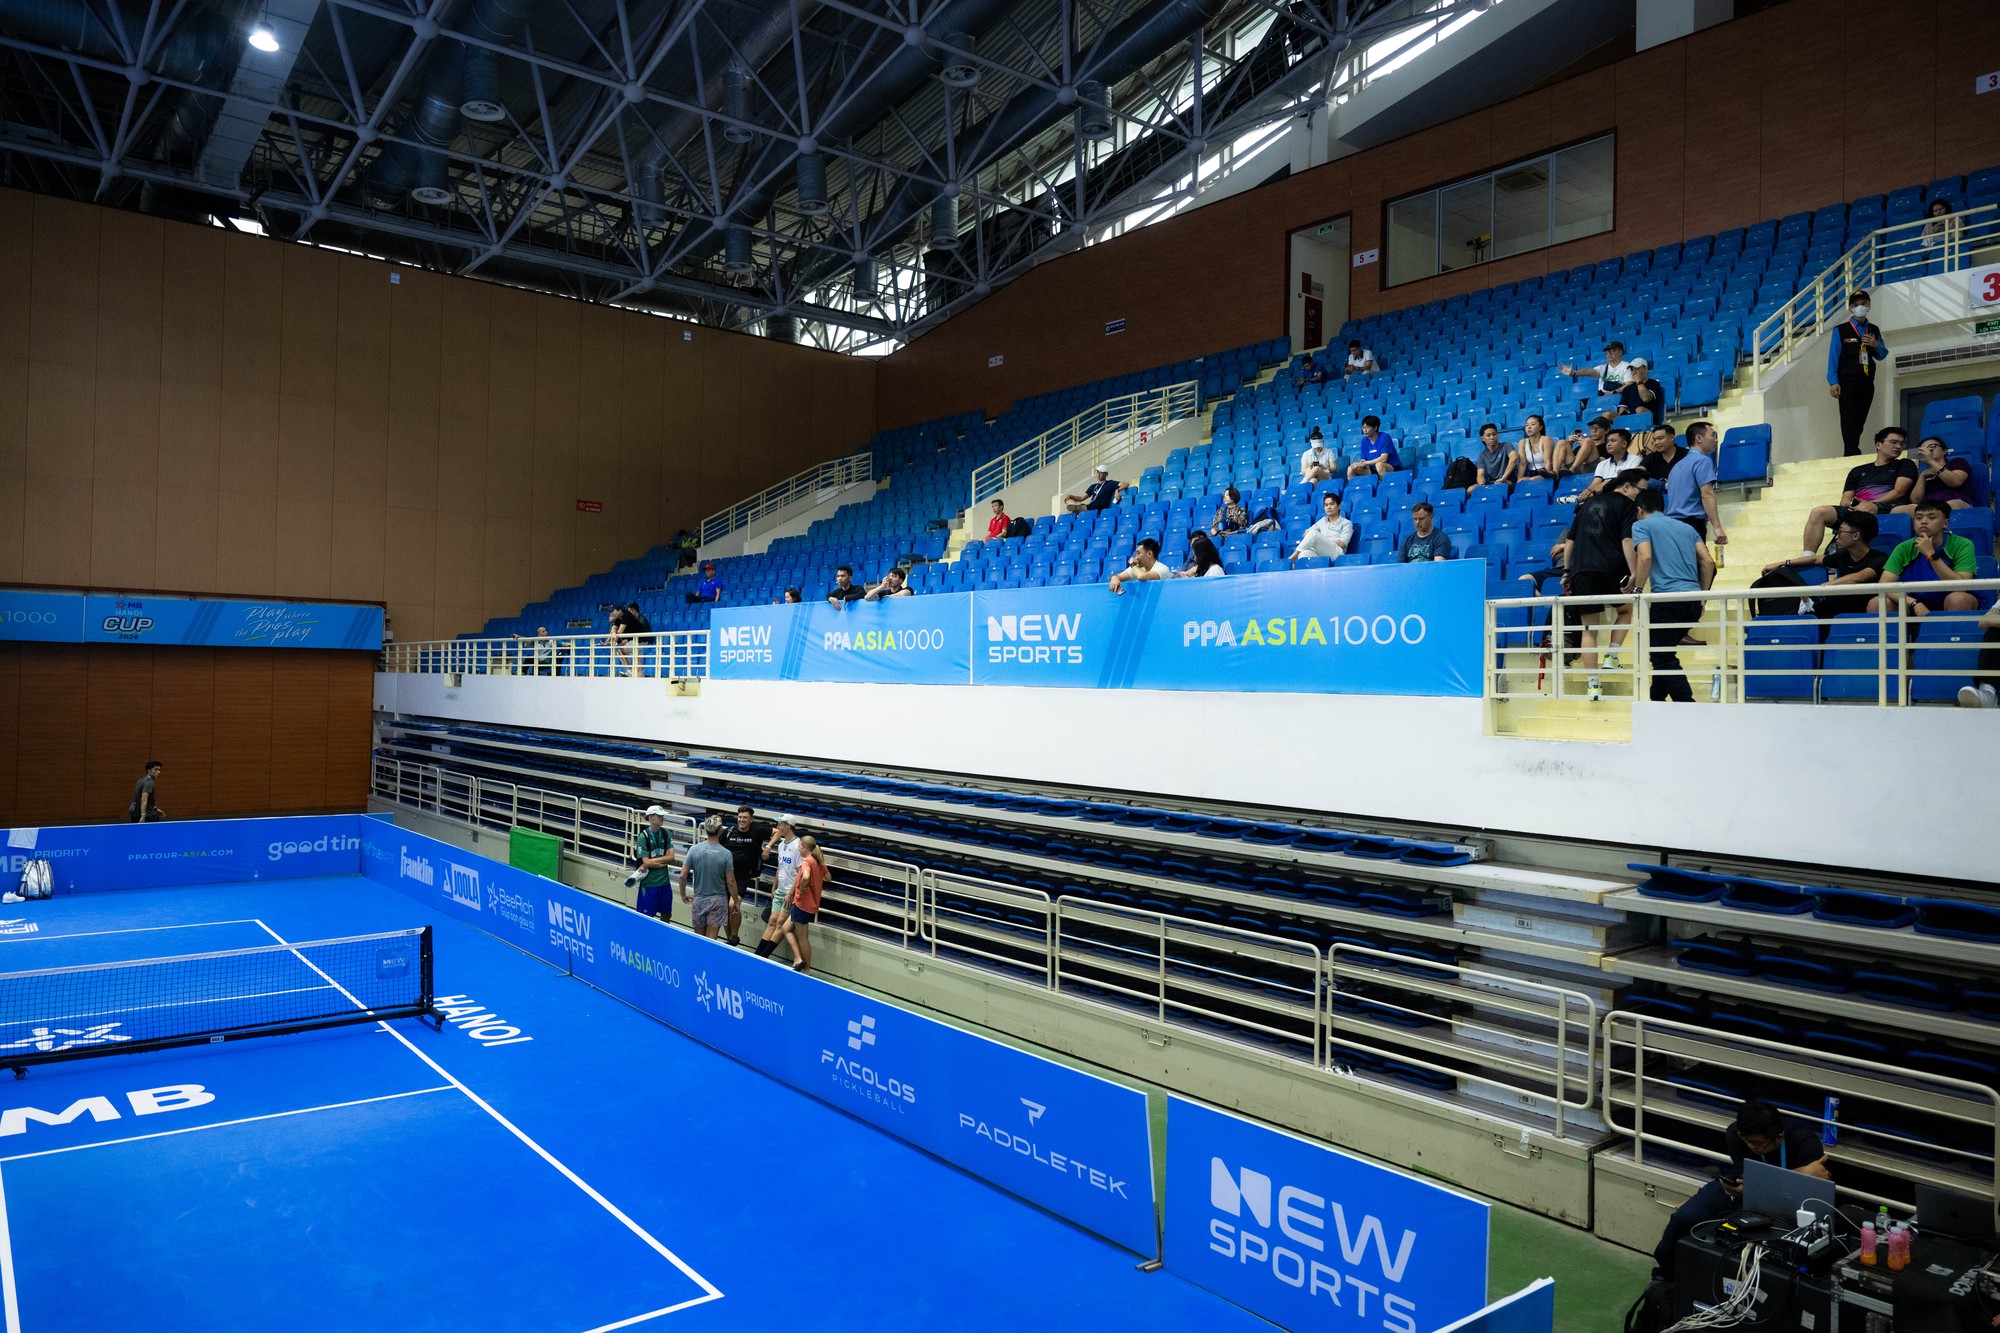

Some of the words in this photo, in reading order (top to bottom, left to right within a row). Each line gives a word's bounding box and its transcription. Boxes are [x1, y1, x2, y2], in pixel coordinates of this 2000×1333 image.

[1989, 75, 1997, 87] 3
[1983, 272, 2000, 301] 3
[5, 610, 57, 624] 1000
[102, 617, 153, 632] CUP
[242, 601, 287, 621] Play
[235, 629, 249, 637] the
[248, 619, 293, 635] Pros
[270, 627, 313, 645] play
[720, 625, 772, 647] NEW
[988, 613, 1082, 642] NEW
[720, 650, 772, 663] SPORTS
[988, 645, 1082, 664] SPORTS
[34, 848, 90, 859] PRIORITY
[400, 845, 434, 886] franklin
[453, 870, 480, 905] JOOLA
[499, 887, 534, 917] BeeRich
[547, 899, 591, 940] NEW
[550, 929, 595, 964] SPORTS
[716, 983, 744, 1020] MB
[745, 990, 785, 1017] PRIORITY
[433, 994, 534, 1047] HANOI
[821, 1049, 916, 1104] FACOLOS
[832, 1074, 905, 1114] PICKLEBALL
[0, 1084, 216, 1137] MB
[959, 1113, 1128, 1200] PADDLETEK
[1210, 1156, 1417, 1283] NEW
[1210, 1218, 1416, 1333] SPORTS
